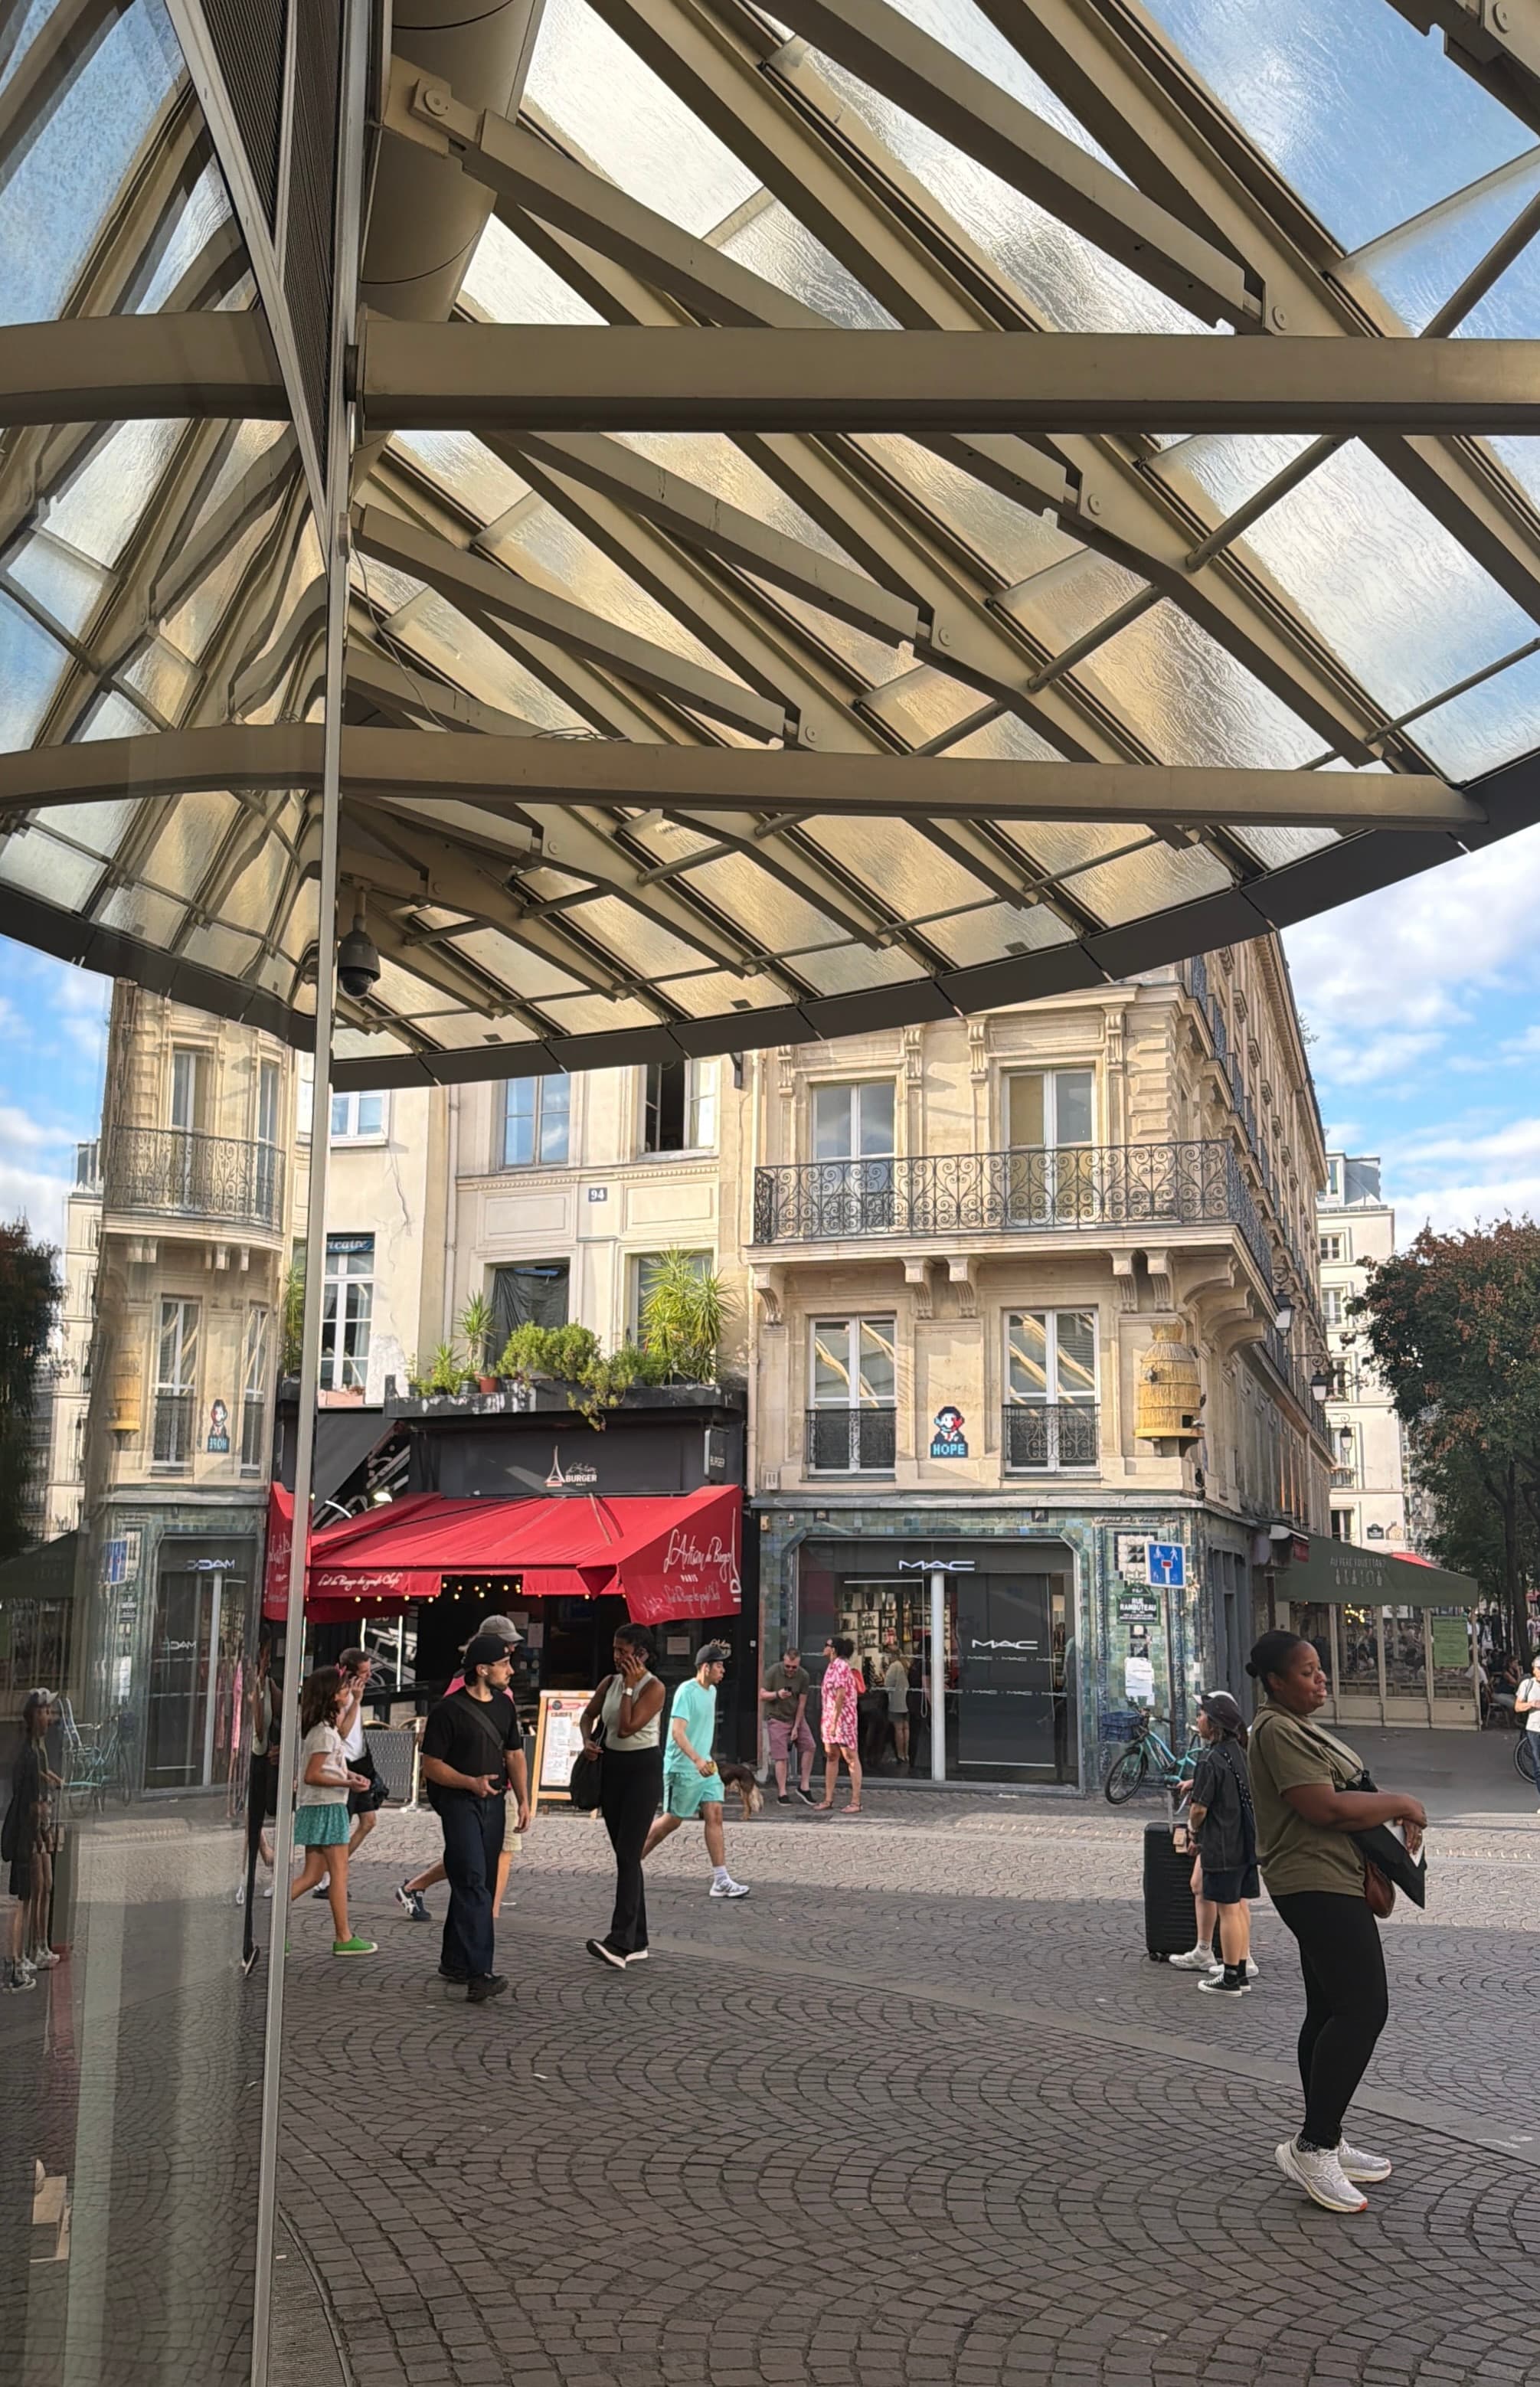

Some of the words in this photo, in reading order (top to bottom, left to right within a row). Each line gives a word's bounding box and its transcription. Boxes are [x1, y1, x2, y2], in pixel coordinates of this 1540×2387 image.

[590, 1189, 605, 1200] 94
[933, 1444, 966, 1455] HOPE
[565, 1474, 597, 1483] BURGER
[972, 1640, 1038, 1650] MAC
